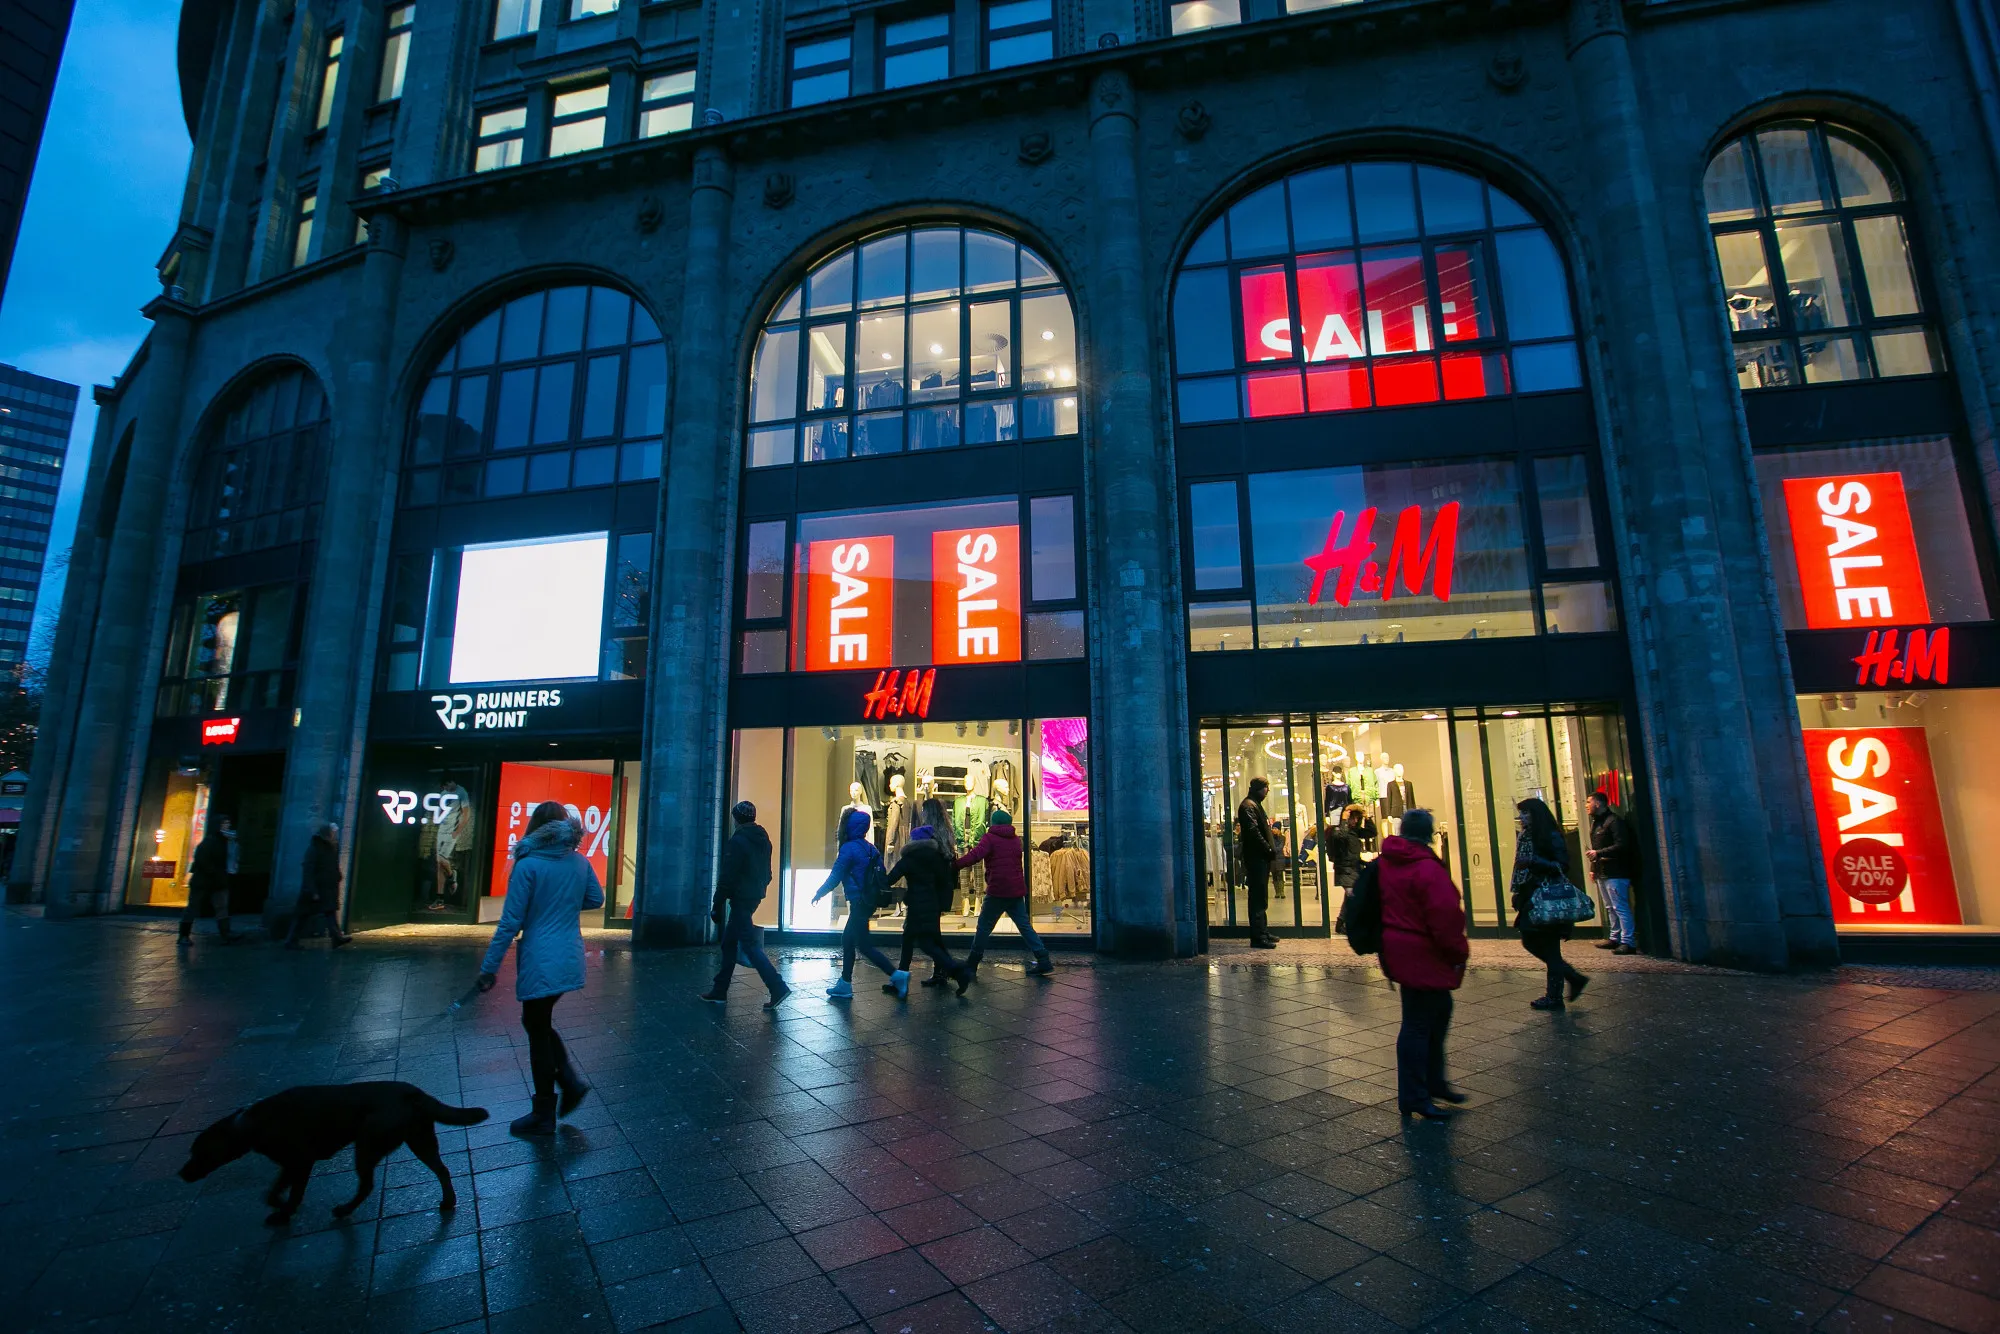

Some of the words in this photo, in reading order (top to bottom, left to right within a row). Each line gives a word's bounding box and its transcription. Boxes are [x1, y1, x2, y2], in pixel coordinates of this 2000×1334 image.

[1304, 501, 1460, 608] H&M
[1816, 481, 1893, 621] SALE
[829, 543, 870, 663] SALE
[956, 533, 998, 657] SALE
[1854, 626, 1950, 687] H&M
[474, 710, 528, 729] POINT
[476, 690, 561, 710] RUNNERS
[864, 668, 937, 720] H&M
[509, 801, 521, 829] TO
[1842, 855, 1895, 871] SALE
[1847, 871, 1894, 886] 70%
